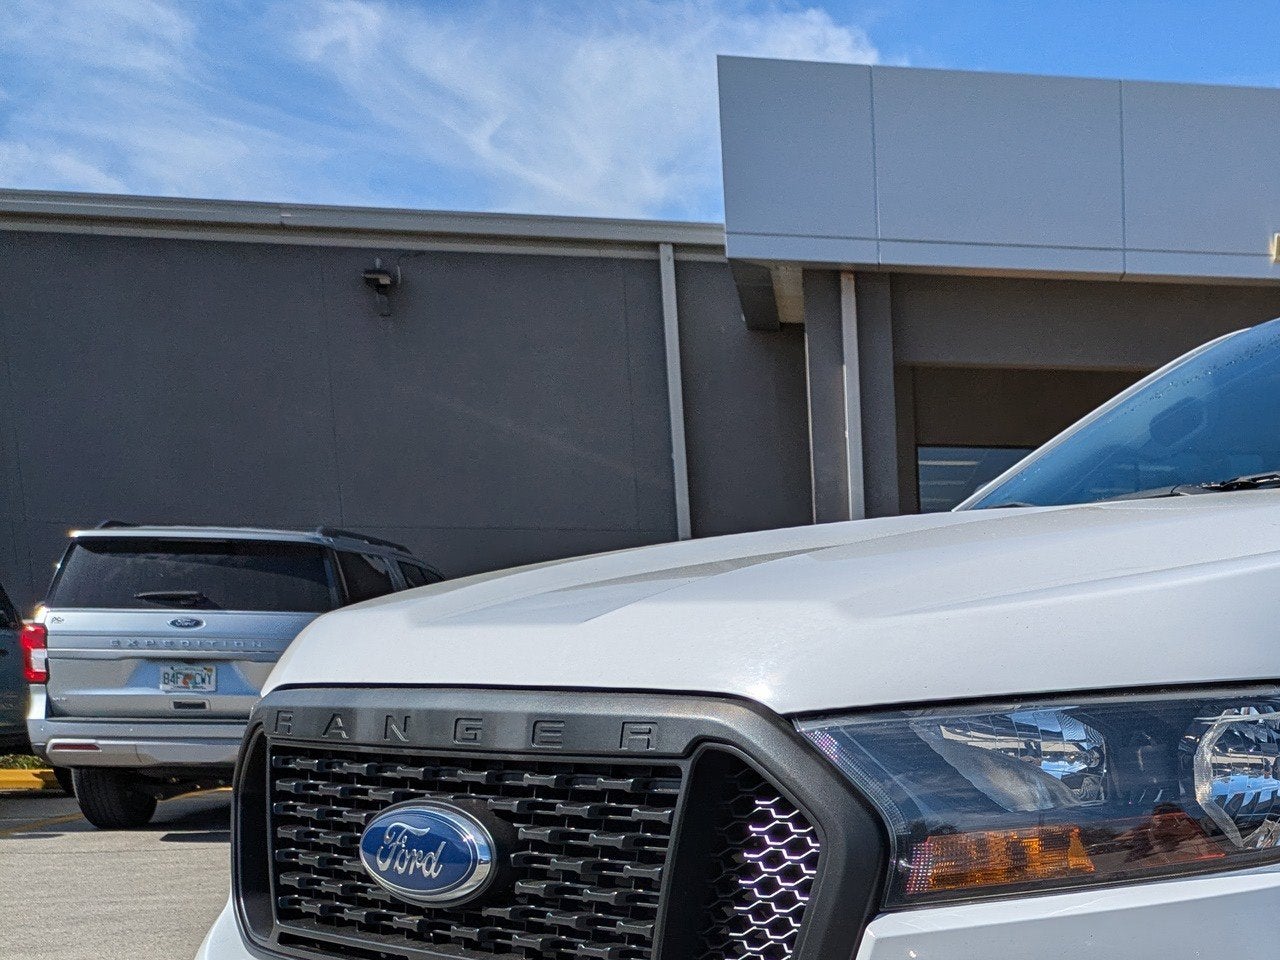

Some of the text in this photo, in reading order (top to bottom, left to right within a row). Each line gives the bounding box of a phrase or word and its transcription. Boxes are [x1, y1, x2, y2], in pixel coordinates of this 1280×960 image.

[110, 639, 263, 648] EXPEDITION
[272, 711, 659, 750] RANGER
[377, 822, 446, 879] Ford
